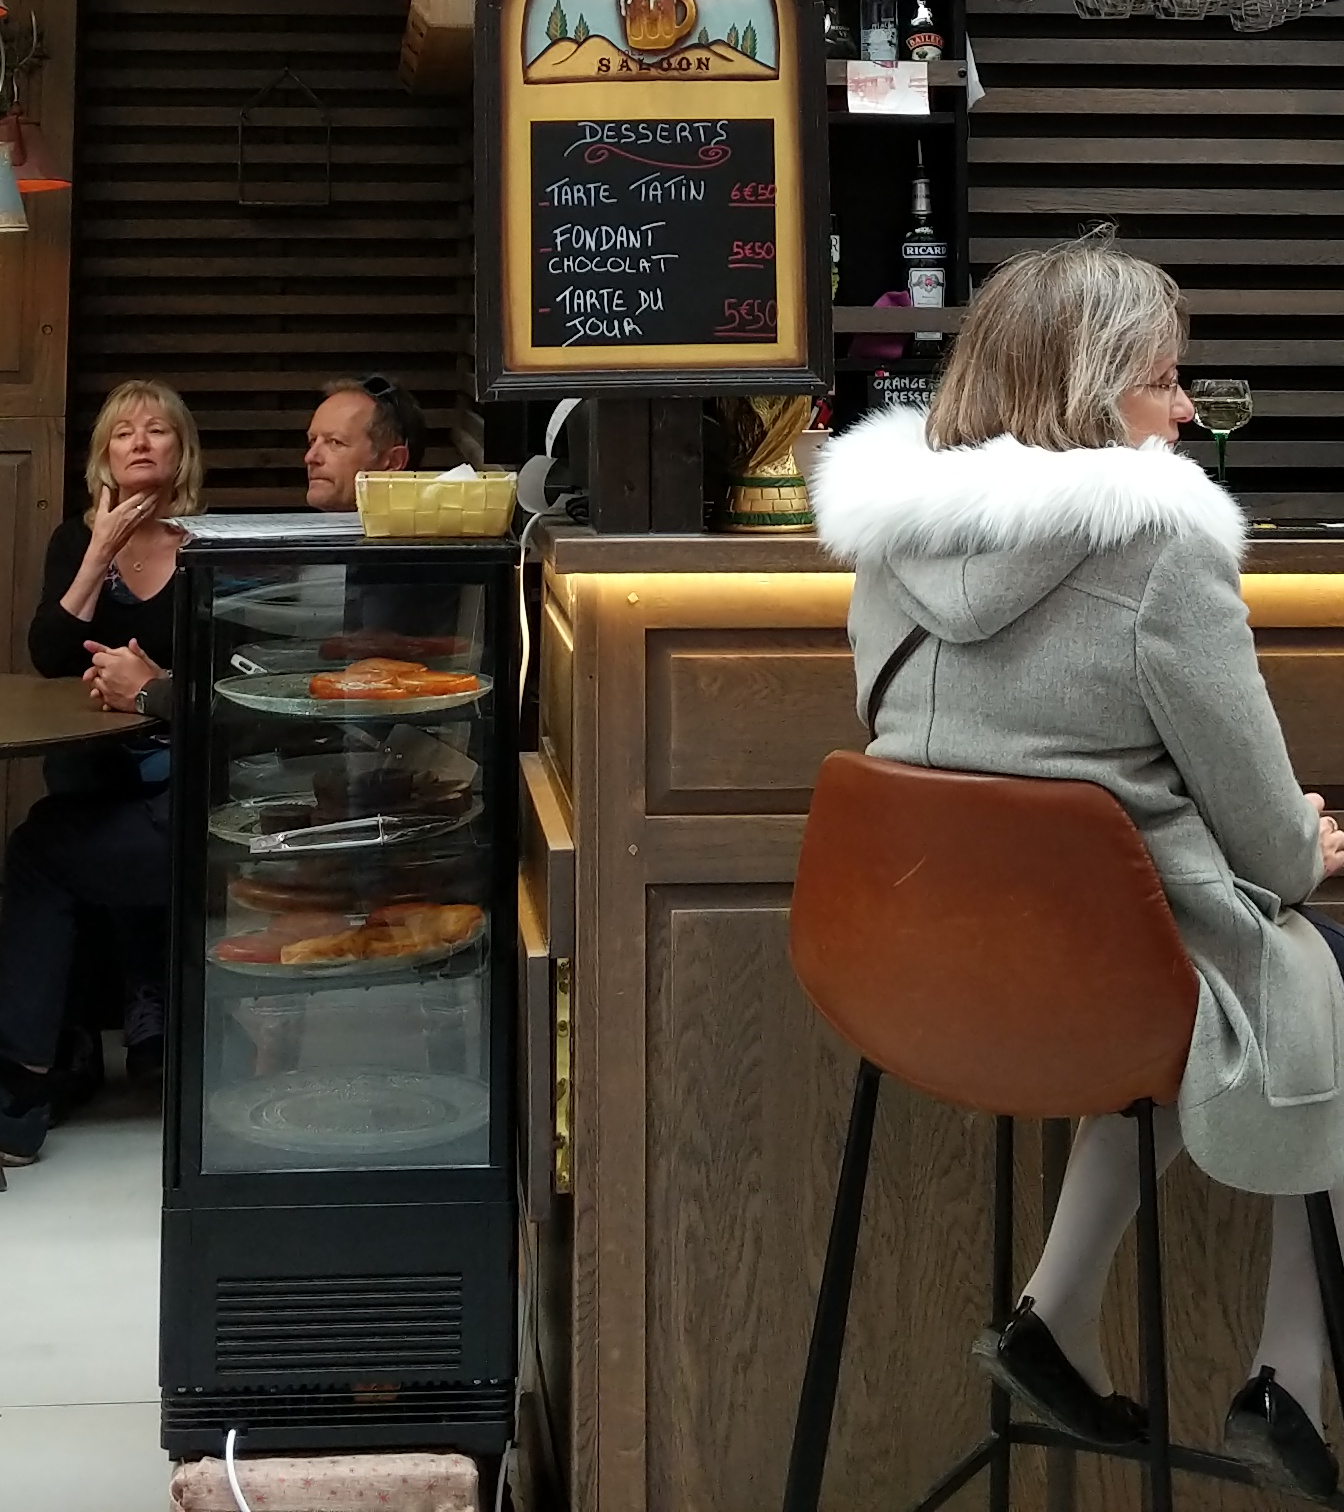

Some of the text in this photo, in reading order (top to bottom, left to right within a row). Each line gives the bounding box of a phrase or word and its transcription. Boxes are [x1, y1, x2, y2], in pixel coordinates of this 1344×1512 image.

[596, 56, 712, 74] SALOON
[564, 120, 729, 157] DESSERTS
[545, 178, 618, 206] TARTE
[730, 182, 777, 201] 6€50
[552, 221, 775, 261] FONDANT 5€50
[906, 246, 947, 255] RICARD
[548, 254, 679, 274] CHOCOLAT
[556, 286, 778, 330] TARTE DU 5€50
[562, 317, 643, 347] JOUR
[873, 376, 927, 389] ORANGE
